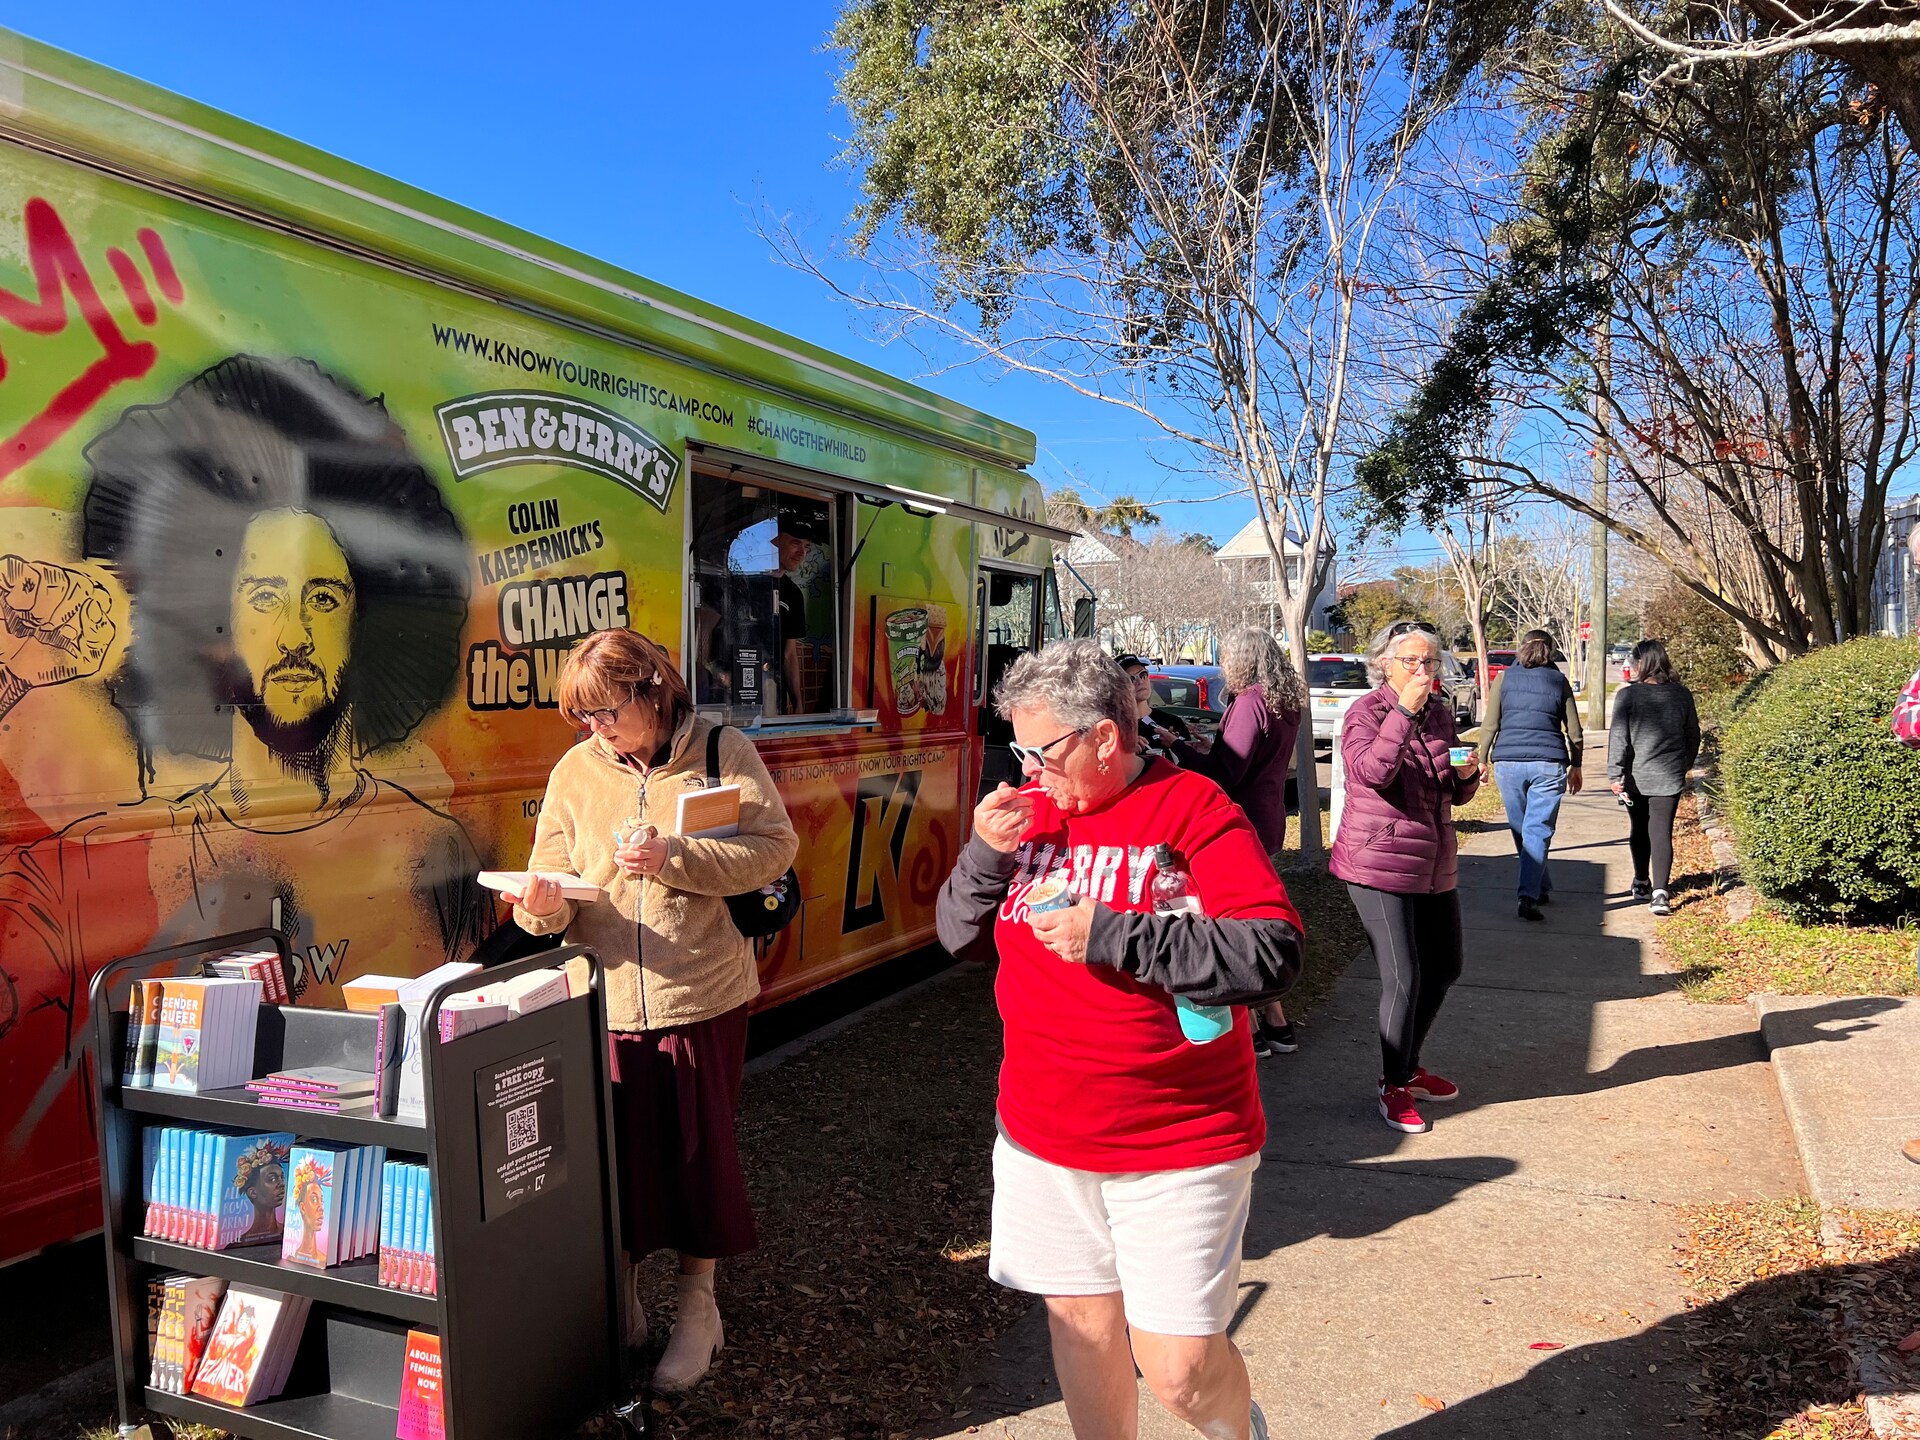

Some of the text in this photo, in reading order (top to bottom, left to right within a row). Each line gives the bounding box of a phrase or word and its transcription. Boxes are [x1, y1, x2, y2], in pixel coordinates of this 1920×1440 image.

[432, 323, 866, 464] WWW.KNOWYOURRIGHTSCAMP.COM #CHANGETHEWHIRLED
[508, 498, 560, 534] COLIN
[478, 520, 604, 586] KAEPERNICK'S
[502, 576, 627, 646] CHANGE
[471, 646, 529, 705] the
[770, 750, 946, 784] ORT HIS NON-PROFIT KNOW YOUR RIGHTS CAMP
[263, 964, 277, 1000] ABOLITION
[273, 960, 287, 996] ABOLITION
[162, 997, 199, 1011] GENDER
[160, 1010, 197, 1025] QUEER
[522, 1056, 544, 1069] download
[495, 1066, 544, 1091] a FREE copy
[497, 1164, 506, 1173] and
[515, 1155, 526, 1166] your
[527, 1150, 538, 1160] FREE
[505, 1174, 520, 1184] Change
[528, 1161, 545, 1173] Whirled
[223, 1199, 248, 1215] BOYS
[220, 1230, 242, 1245] BLUE
[197, 1358, 244, 1394] FLAMER
[410, 1362, 442, 1378] FEMINIS
[417, 1377, 439, 1391] NOW.
